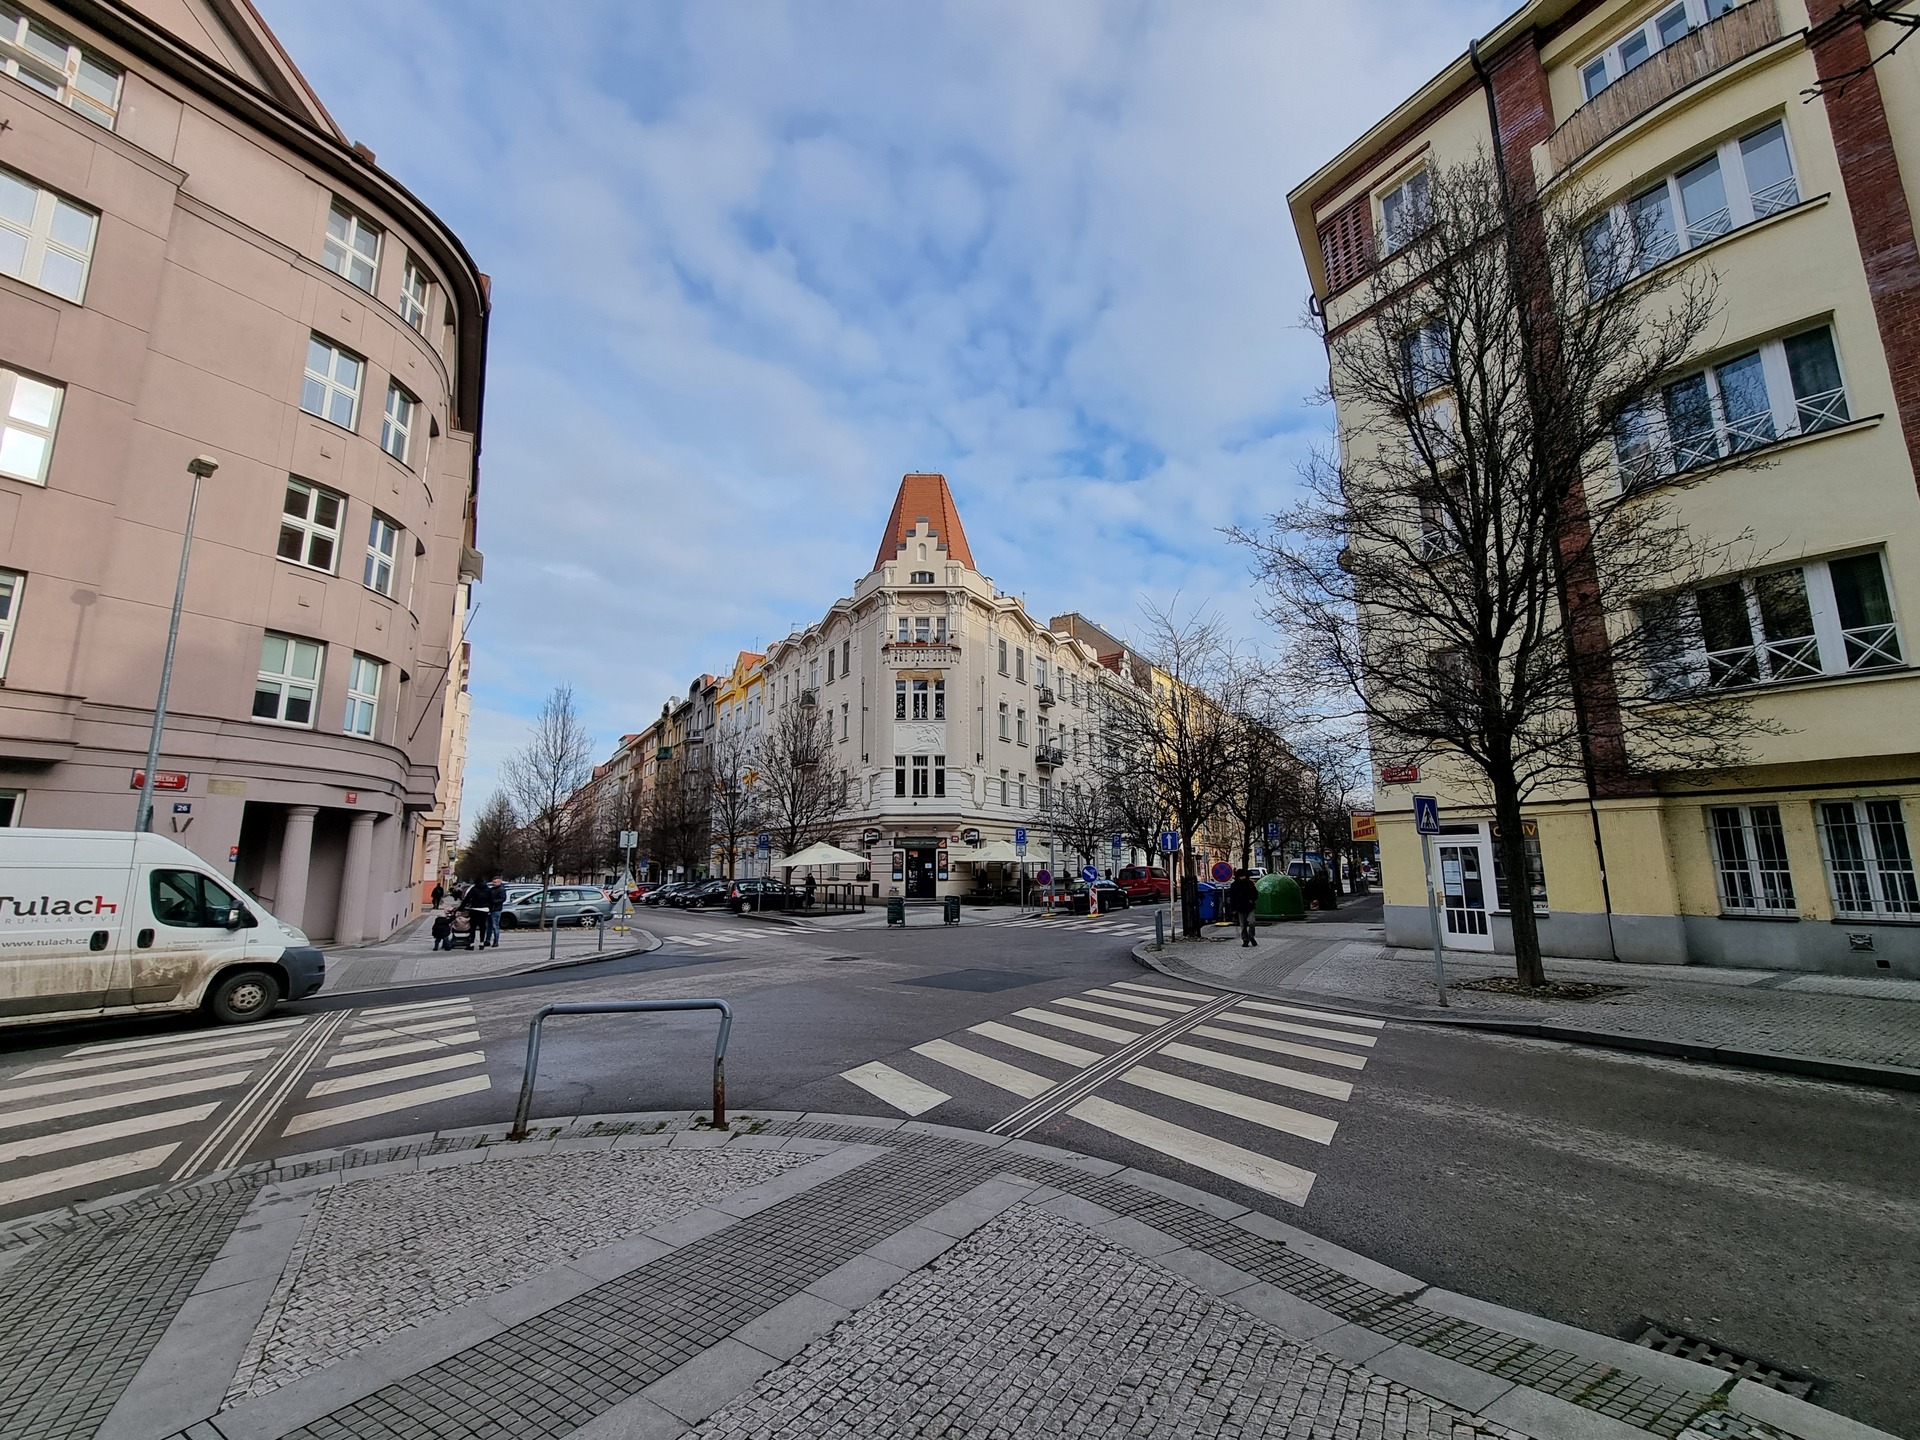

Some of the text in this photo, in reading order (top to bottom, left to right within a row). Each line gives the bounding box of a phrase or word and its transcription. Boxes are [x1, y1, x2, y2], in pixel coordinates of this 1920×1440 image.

[176, 804, 188, 812] 26
[0, 895, 117, 916] Tulach
[1, 937, 88, 948] www.tulach.cz
